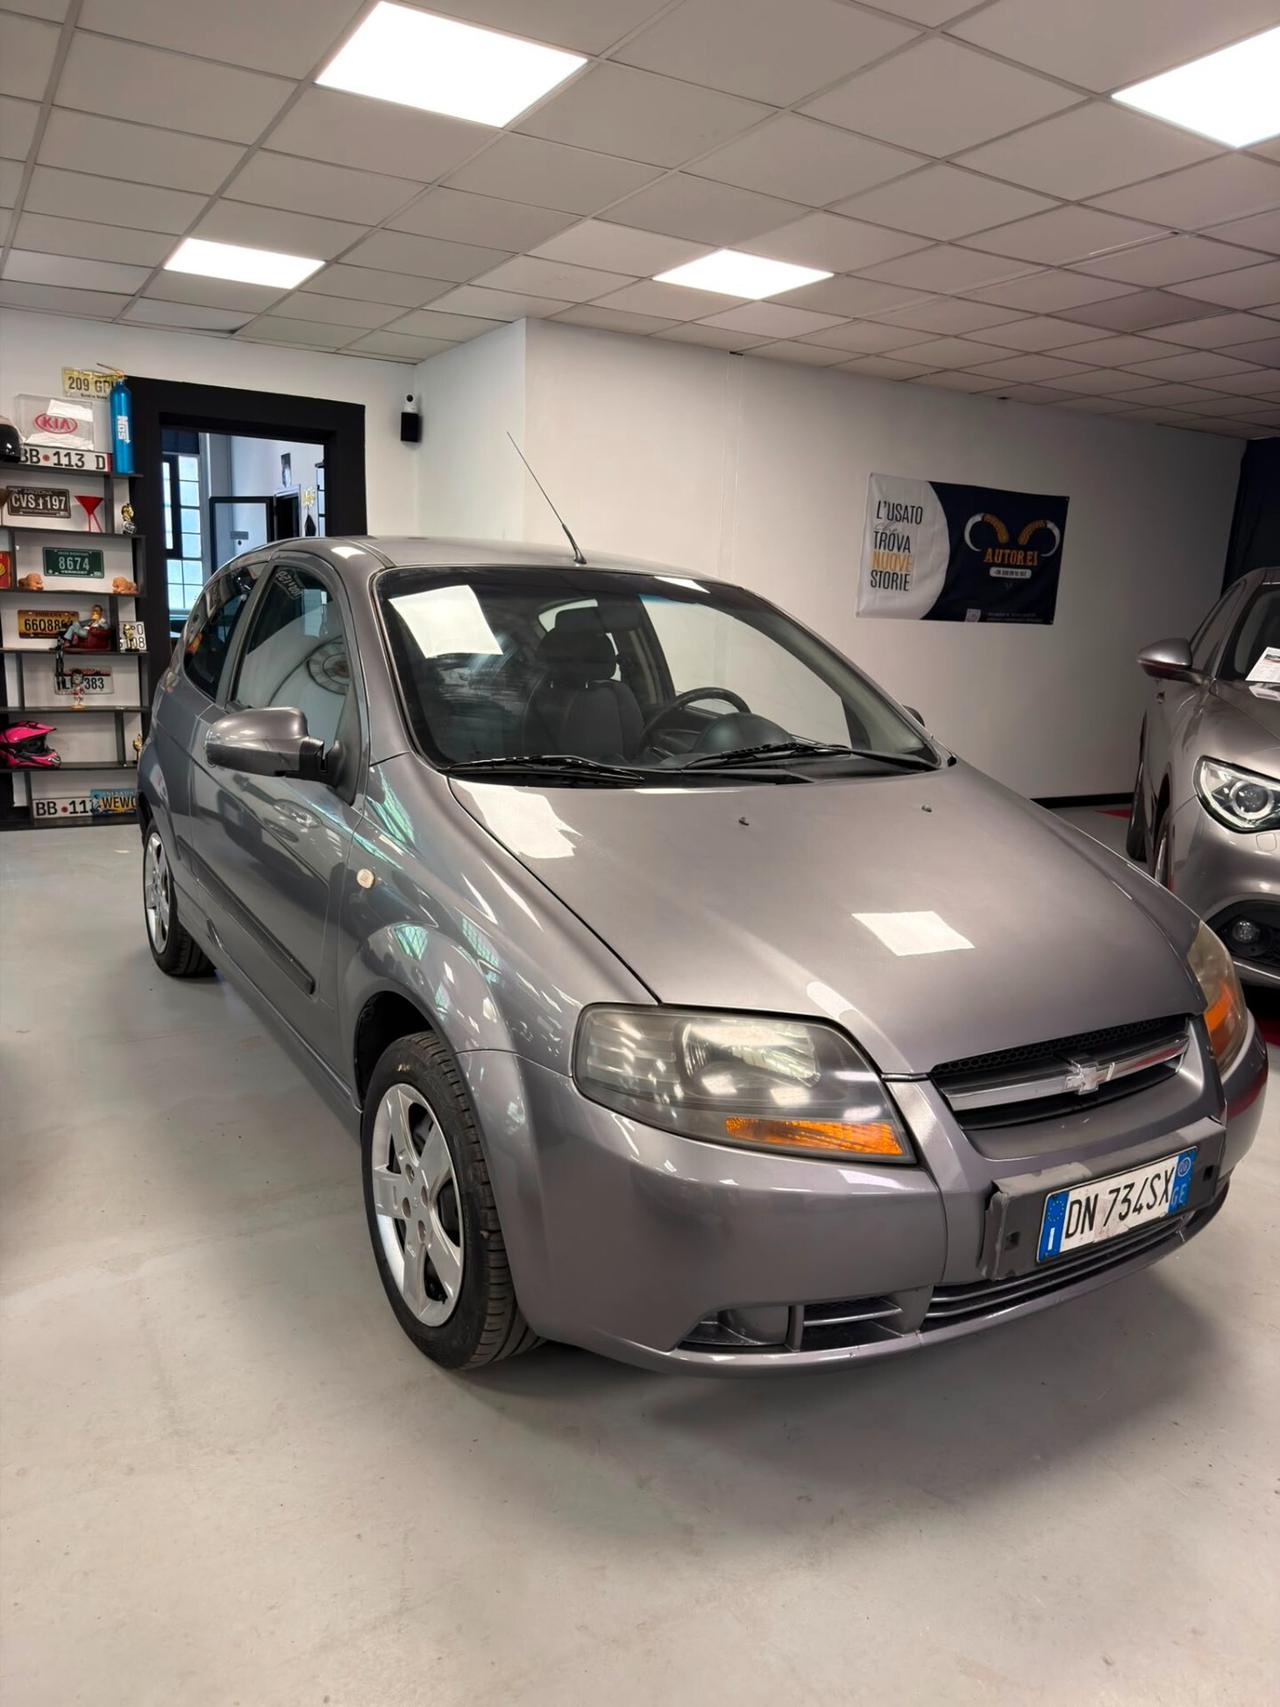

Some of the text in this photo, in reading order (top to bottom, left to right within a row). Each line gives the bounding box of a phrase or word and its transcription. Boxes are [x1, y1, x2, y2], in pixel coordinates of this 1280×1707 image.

[68, 376, 90, 391] 209
[42, 416, 70, 430] KIA
[53, 451, 85, 468] 113
[95, 455, 106, 470] D
[876, 500, 923, 525] L'USATO
[873, 531, 911, 553] TROVA
[58, 556, 89, 571] 8674
[871, 552, 913, 573] NUOVE
[870, 569, 911, 592] STORIE
[83, 677, 104, 690] 383
[35, 801, 58, 816] BB
[1064, 1167, 1175, 1239] DN 734SX
[1171, 1183, 1187, 1208] GE
